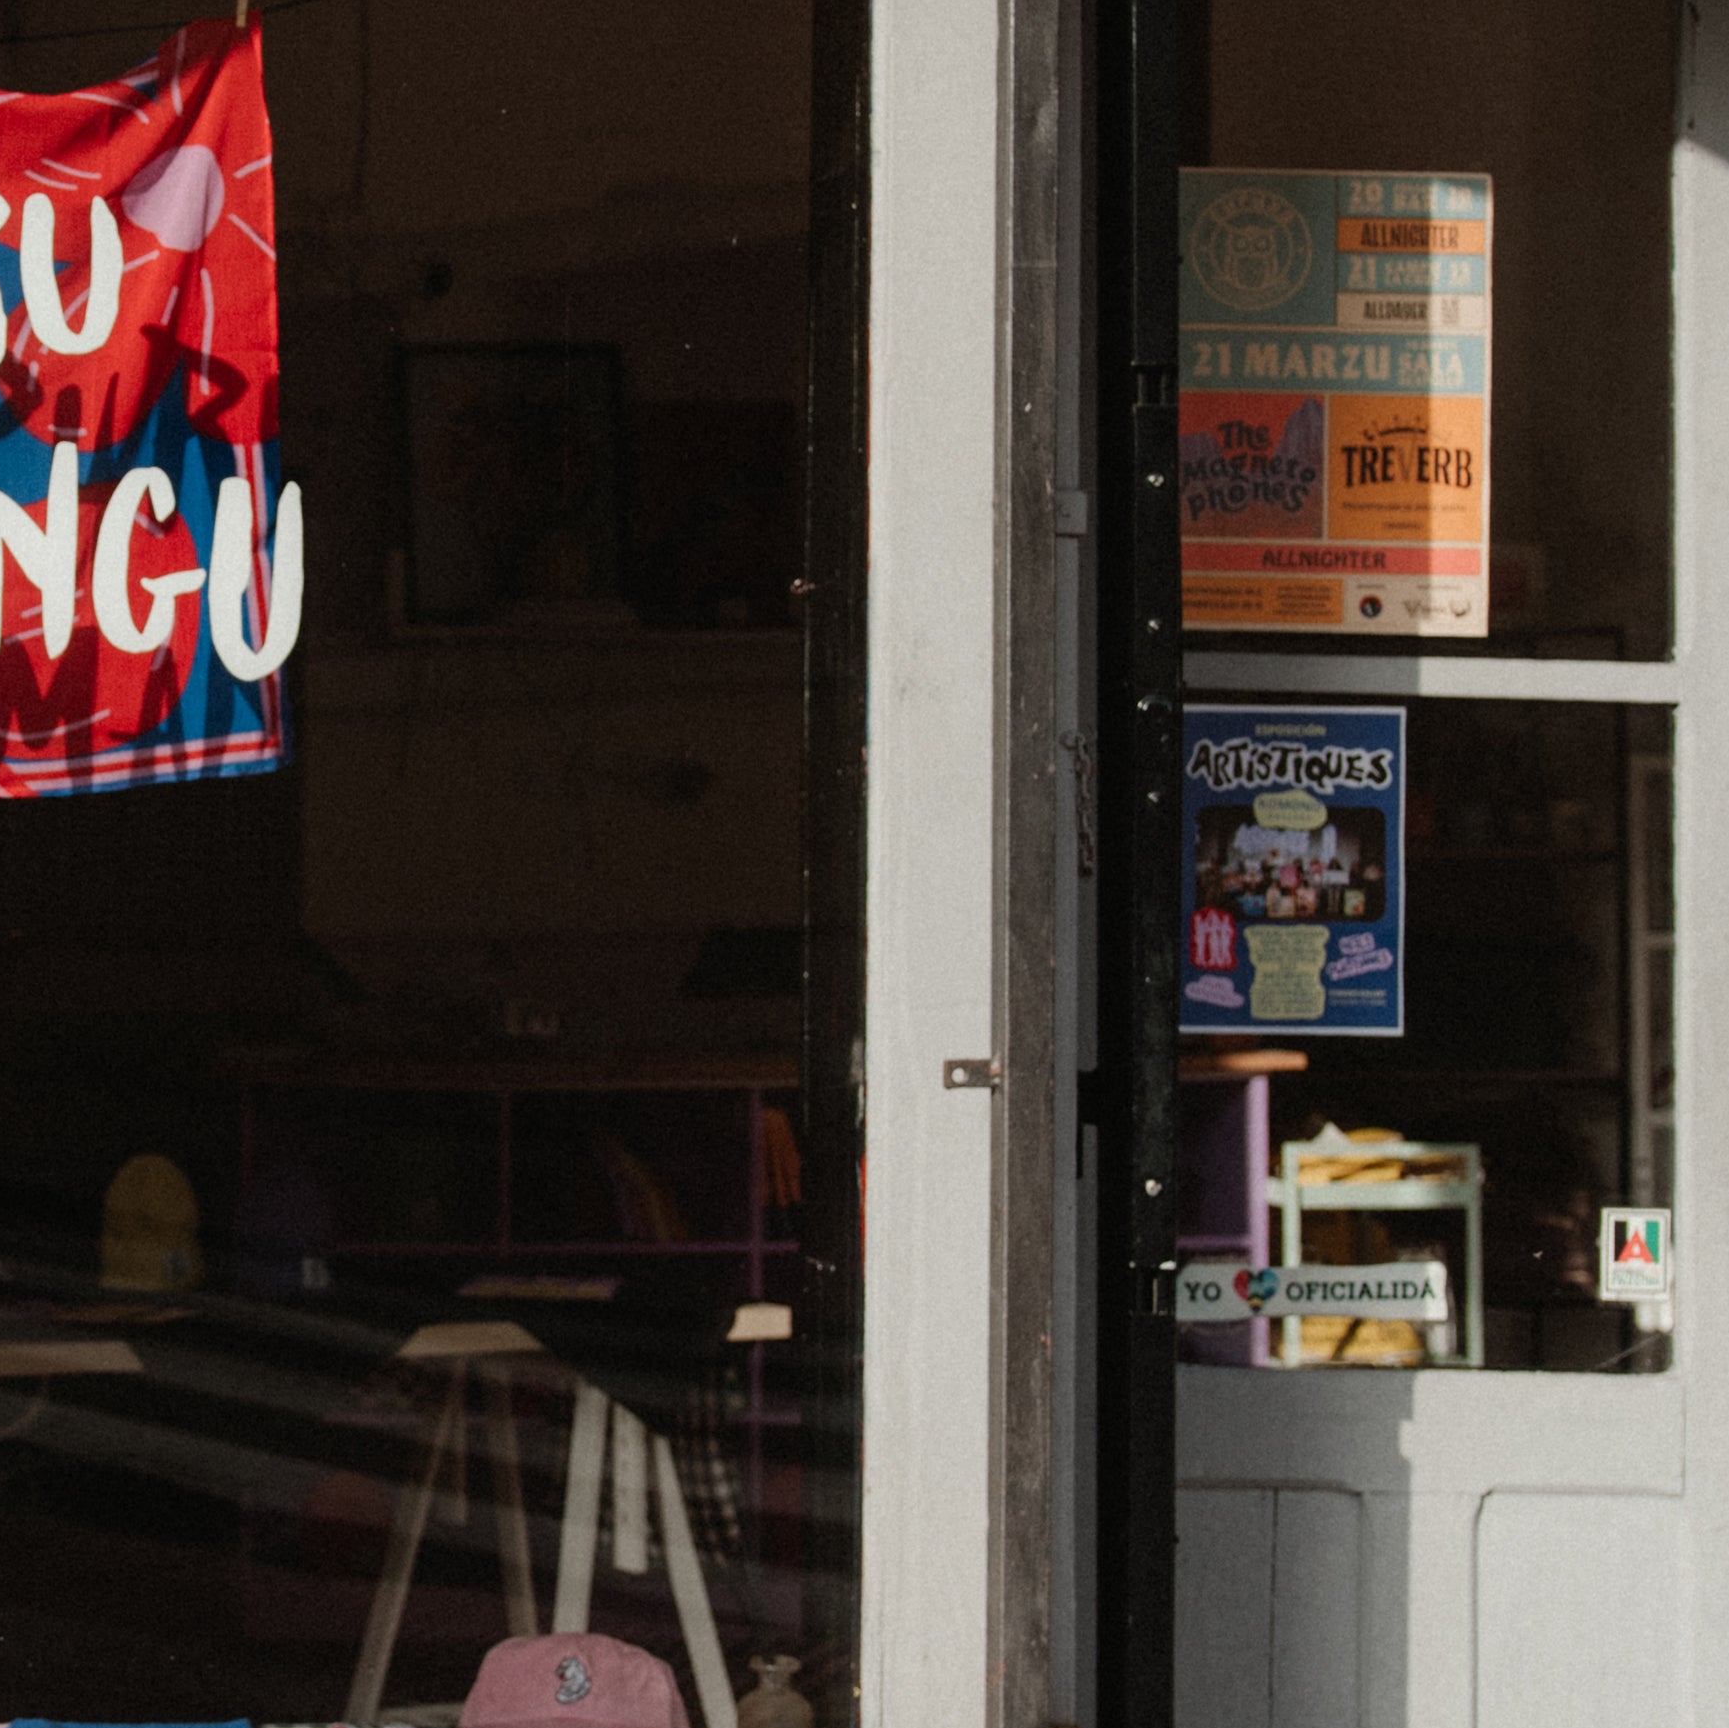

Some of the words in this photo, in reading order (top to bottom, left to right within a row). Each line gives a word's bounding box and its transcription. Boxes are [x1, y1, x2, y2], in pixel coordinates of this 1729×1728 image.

[1192, 341, 1232, 378] 21
[1243, 341, 1390, 381] MARZU
[1217, 420, 1271, 450] The
[1261, 548, 1386, 570] ALLNIGHTER
[1184, 1281, 1222, 1302] YO
